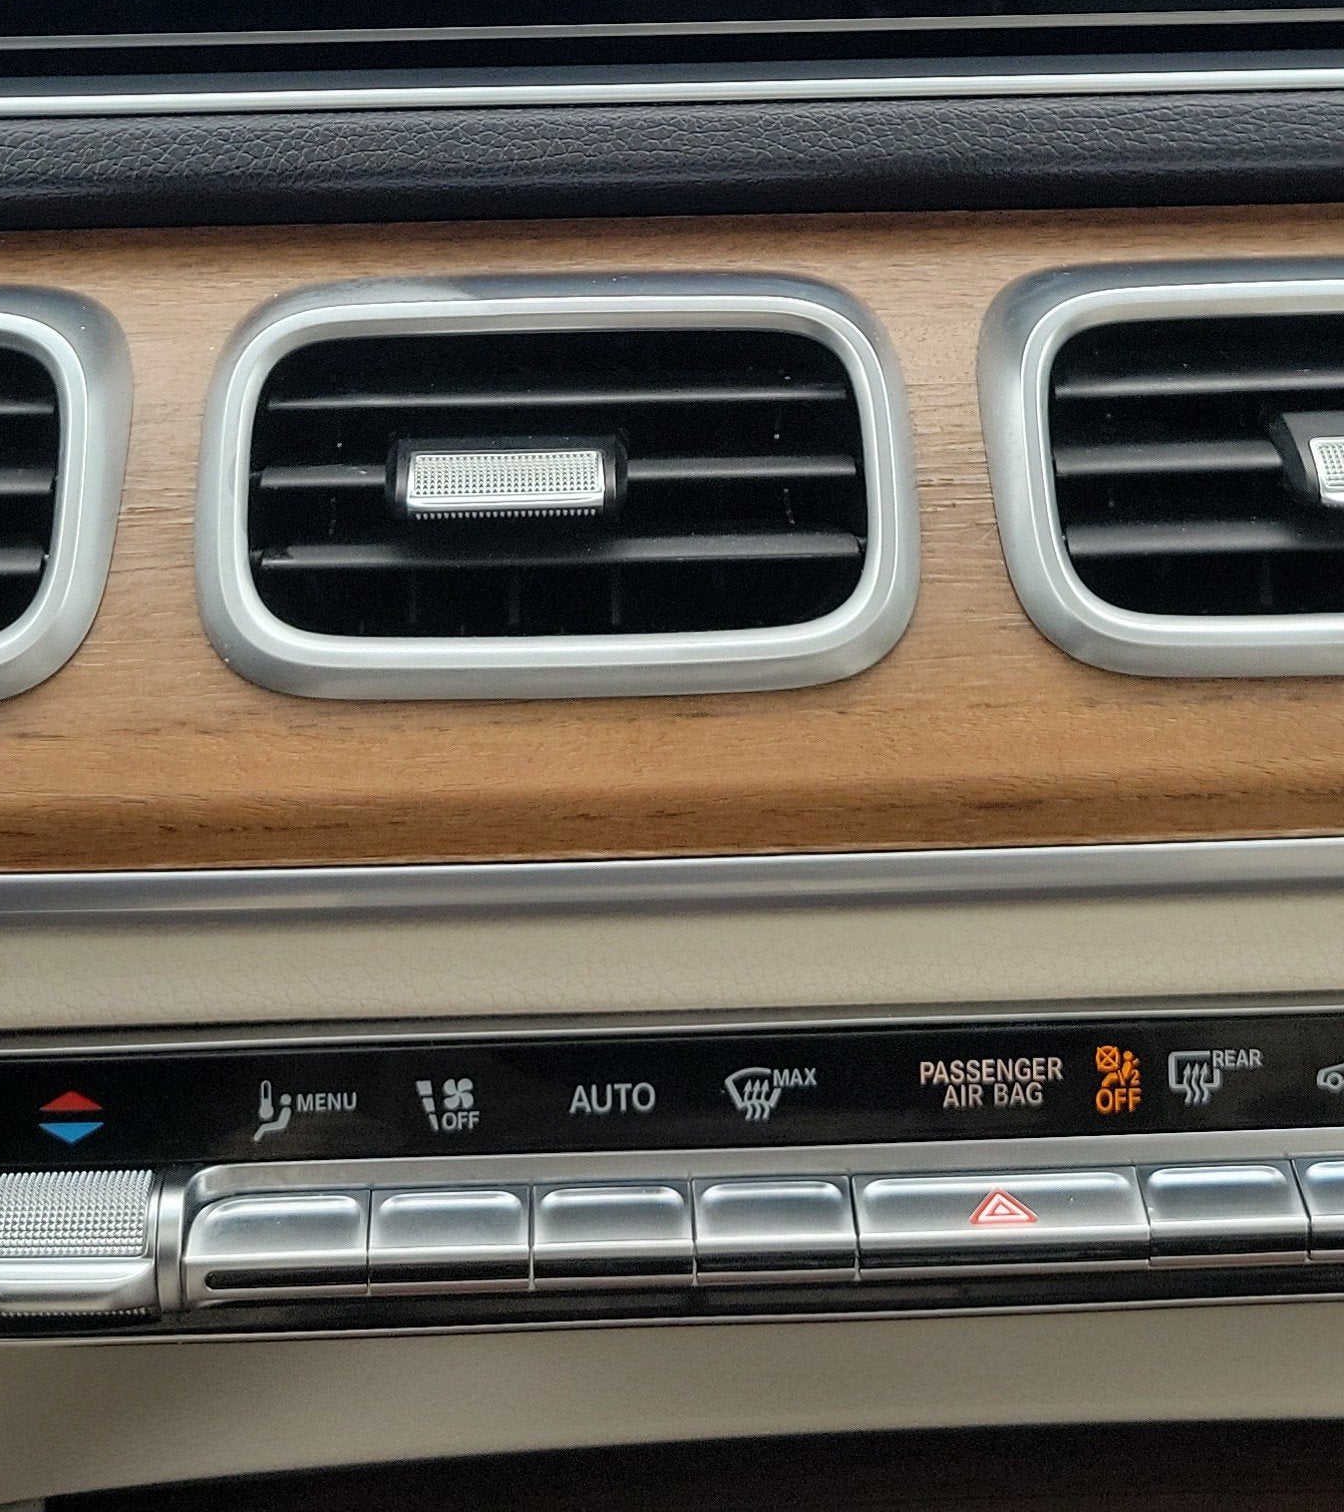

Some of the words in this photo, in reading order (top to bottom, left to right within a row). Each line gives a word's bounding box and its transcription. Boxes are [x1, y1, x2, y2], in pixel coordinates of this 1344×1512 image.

[1212, 1049, 1263, 1068] REAR
[773, 1068, 817, 1087] MAX
[920, 1056, 1064, 1086] PASSENGER
[297, 1092, 357, 1112] MENU
[569, 1082, 656, 1114] AUTO
[943, 1083, 983, 1107] AIR
[994, 1082, 1043, 1106] BAG
[1095, 1088, 1142, 1112] OFF
[441, 1110, 480, 1130] OFF
